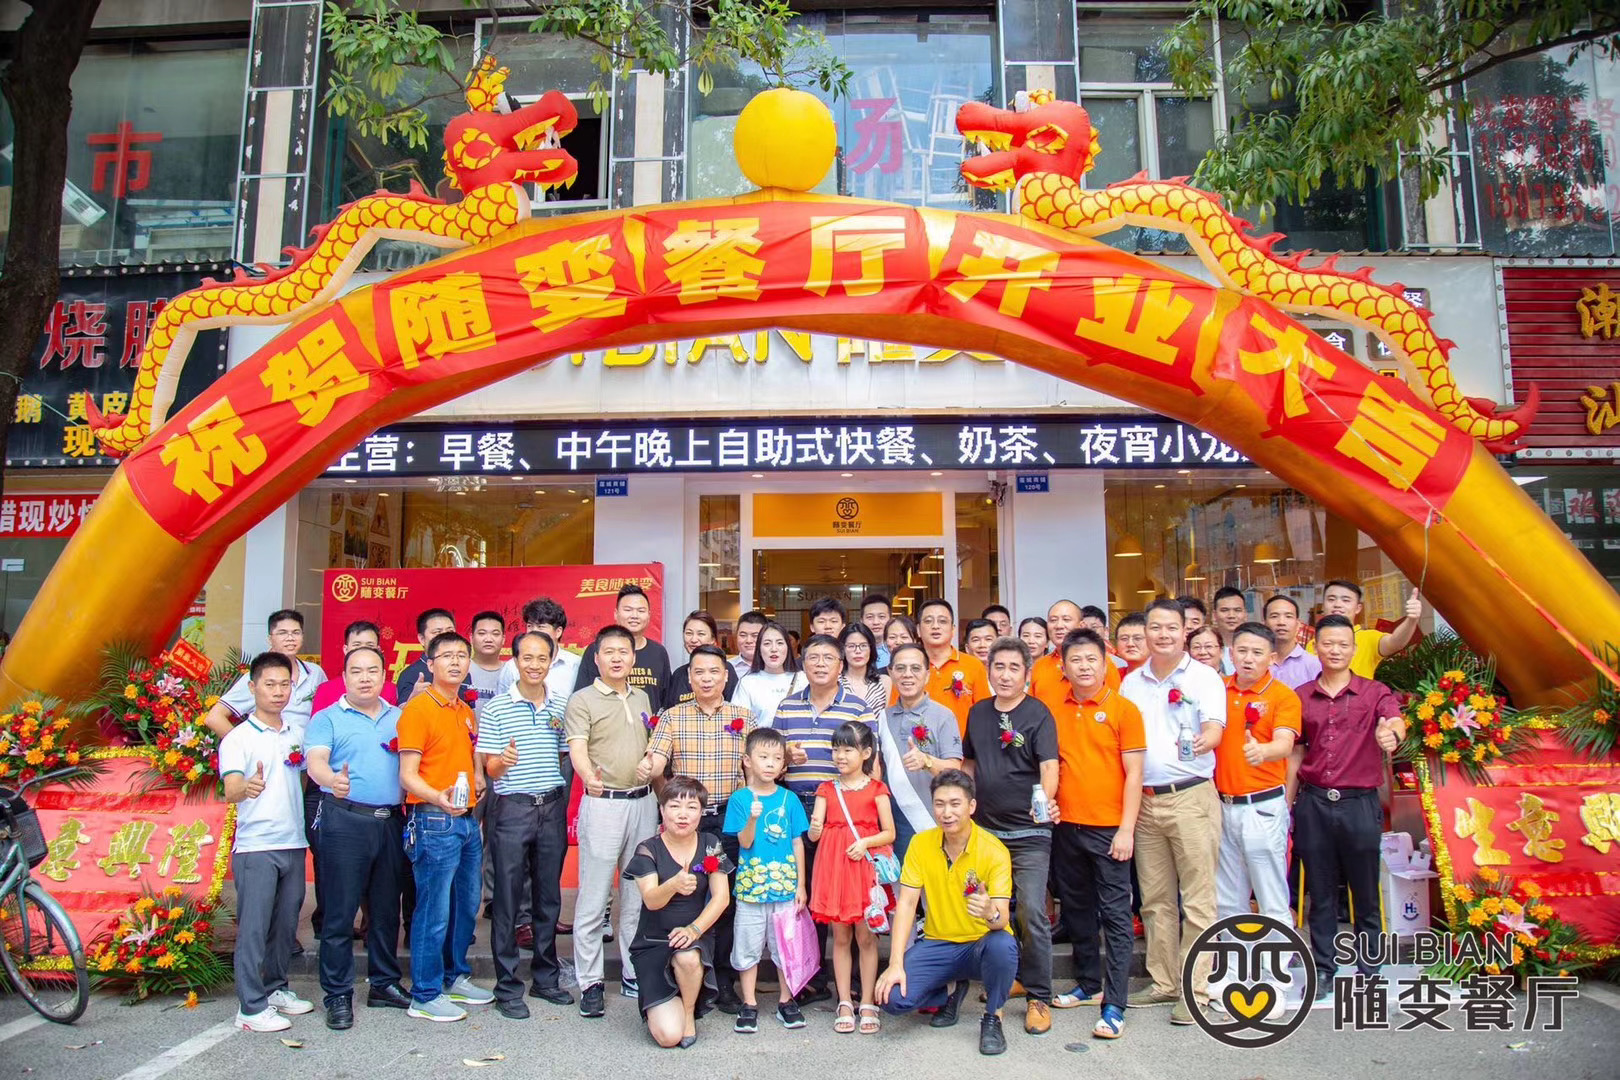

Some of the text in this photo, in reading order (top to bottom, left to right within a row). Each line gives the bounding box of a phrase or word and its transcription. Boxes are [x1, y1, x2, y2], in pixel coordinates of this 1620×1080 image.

[87, 121, 163, 198] 市
[361, 578, 375, 586] SUI
[360, 586, 409, 599] 随变餐厅
